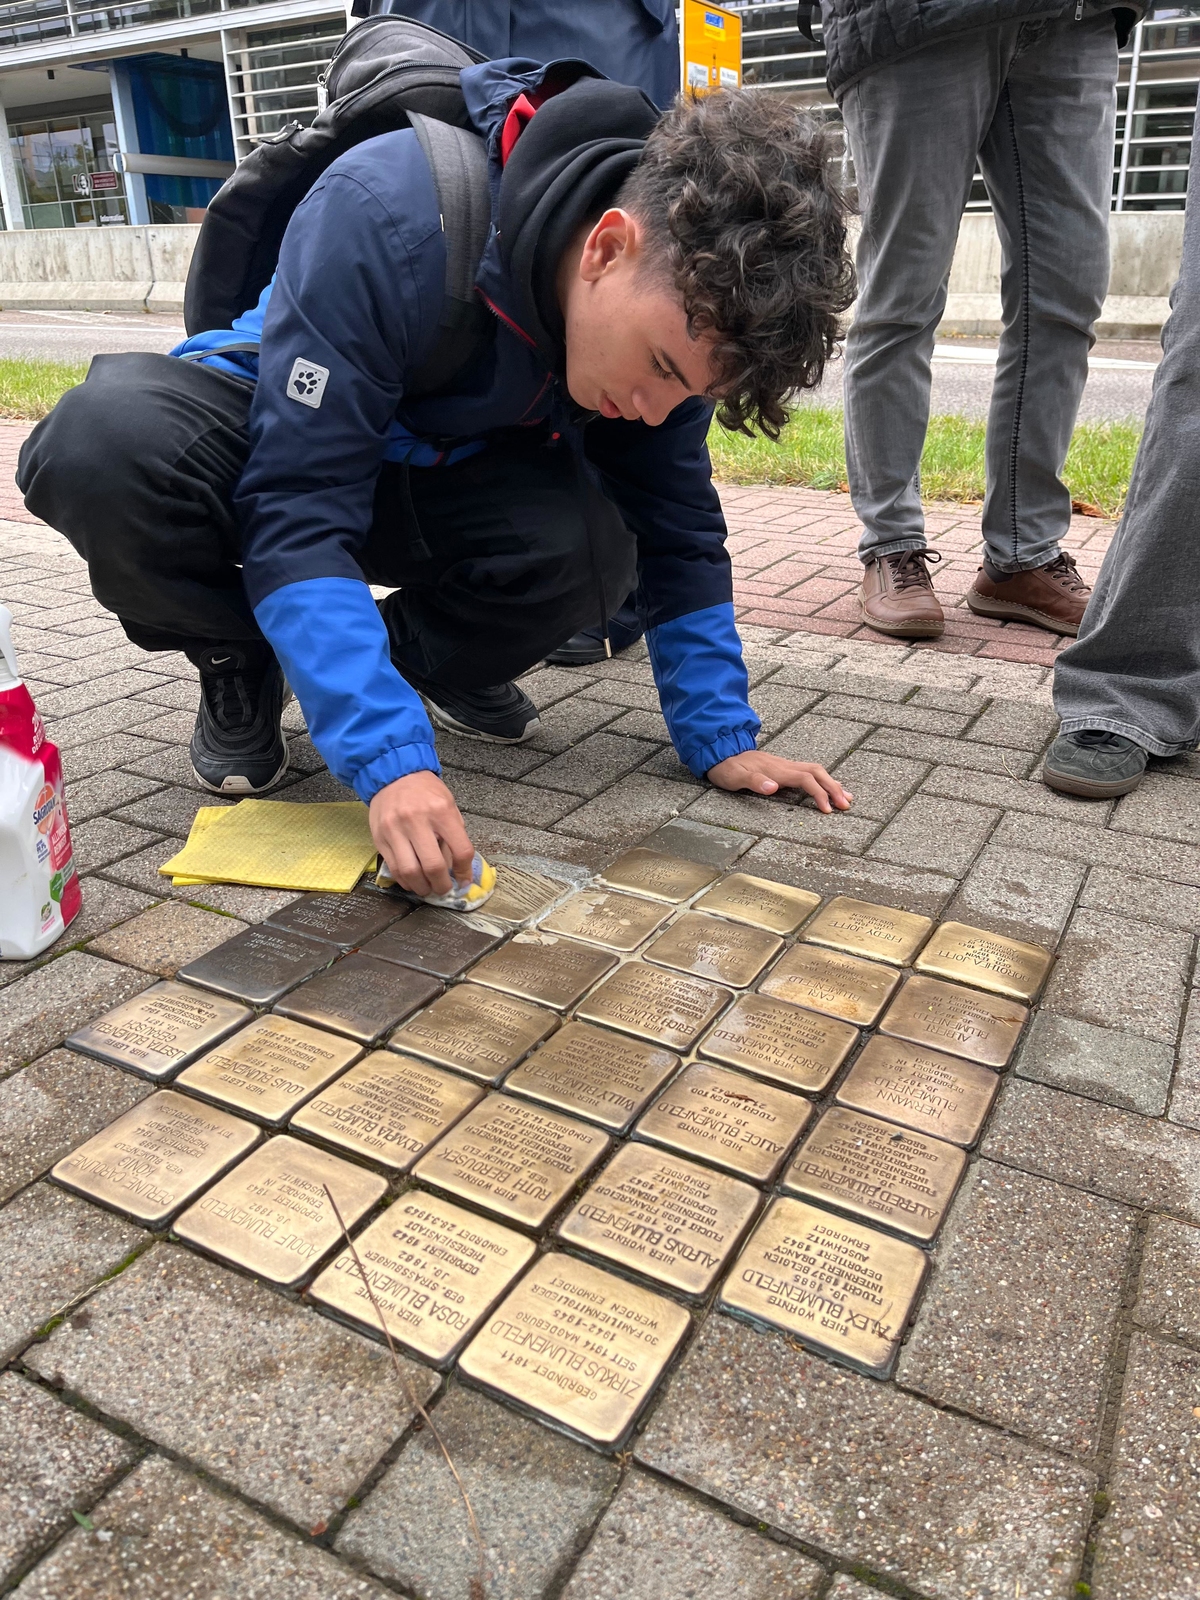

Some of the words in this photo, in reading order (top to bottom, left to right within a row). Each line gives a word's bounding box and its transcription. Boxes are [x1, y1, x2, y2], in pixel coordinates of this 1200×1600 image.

[827, 920, 863, 932] JOFFE
[865, 928, 902, 943] FREDY
[675, 942, 743, 964] BLUMENFELD
[685, 952, 720, 965] CLARA
[936, 949, 970, 962] JOFFE
[971, 958, 1028, 980] DOROTHEA
[787, 975, 860, 1001] BLUMENFELD
[806, 988, 835, 1001] CARL
[139, 1005, 161, 1014] 1942
[148, 1001, 208, 1023] THERESIENSTADT
[160, 1012, 203, 1029] DEPORTIERT
[591, 997, 664, 1022] BLUMENFELD
[87, 1020, 150, 1045] BLUMENFELD
[121, 1019, 178, 1042] GERAUSCH
[659, 1017, 696, 1034] ERICH
[911, 1012, 989, 1039] BLUMENFELD
[923, 1023, 971, 1042] ALBERT
[102, 1038, 130, 1050] LEBTE
[143, 1039, 188, 1060] LISETTA
[242, 1042, 264, 1052] 1942
[252, 1037, 317, 1062] THERESIENSTADT
[405, 1024, 479, 1053] BLUMENFELD
[421, 1039, 456, 1055] WOHNTE
[712, 1028, 786, 1057] BLUMENFELD
[128, 1047, 149, 1058] HIER
[264, 1050, 310, 1070] DEPORTIERT
[454, 1051, 476, 1063] HIER
[475, 1047, 511, 1064] FRITZ
[734, 1045, 772, 1061] WOHNTE
[772, 1058, 794, 1069] HIER
[786, 1053, 831, 1074] ULRICH
[205, 1054, 274, 1083] BLUMENFELD
[398, 1067, 443, 1087] ERMORDET
[522, 1064, 600, 1095] BLUMENFELD
[218, 1074, 246, 1087] LEBTE
[244, 1083, 266, 1095] HIER
[269, 1077, 306, 1095] LOUIS
[357, 1079, 394, 1096] DRANCY
[369, 1074, 394, 1086] 1942
[390, 1073, 438, 1095] AUSCHWITZ
[538, 1081, 576, 1097] WOHNTE
[337, 1081, 391, 1104] FRANKREICH
[393, 1084, 444, 1107] DEPORTIERT
[576, 1094, 600, 1106] HIER
[595, 1090, 637, 1110] WILLY
[689, 1087, 709, 1097] TOD
[709, 1093, 729, 1103] DEN
[873, 1076, 958, 1111] BLUMENFELD
[388, 1101, 412, 1113] 1938
[391, 1093, 440, 1115] INTERNIERT
[729, 1100, 741, 1108] IN
[741, 1104, 777, 1121] FLUCHT
[875, 1089, 942, 1118] HERMANN
[166, 1118, 203, 1135] BEFREIT
[309, 1099, 379, 1132] BLUMENFELD
[410, 1110, 443, 1126] FLUCHT
[491, 1117, 516, 1130] 1942
[656, 1102, 741, 1137] BLUMENFELD
[133, 1126, 155, 1138] 1944
[144, 1120, 209, 1150] THERESIENSTADT
[328, 1120, 364, 1138] WOHNTE
[374, 1125, 425, 1152] OLYMPIA
[480, 1122, 518, 1140] DRANCY
[512, 1117, 564, 1140] AUSCHWITZ
[675, 1121, 717, 1140] WOHNTE
[156, 1135, 204, 1158] DEPORTIERT
[362, 1135, 386, 1148] HIER
[518, 1128, 572, 1152] DEPORTIERT
[518, 1137, 572, 1162] INTERNIERT
[718, 1137, 743, 1151] HIER
[739, 1131, 785, 1154] ALICE
[851, 1135, 914, 1161] AUSCHWITZ
[112, 1141, 163, 1165] BLUMENFELD
[66, 1153, 129, 1184] CAROLINE
[115, 1155, 158, 1178] KÖNIG
[162, 1161, 184, 1174] GEB.
[436, 1147, 511, 1183] BEROUSEK
[262, 1177, 276, 1186] IN
[277, 1172, 329, 1198] AUSCHWITZ
[452, 1169, 494, 1189] WOHNTE
[628, 1176, 655, 1190] 1942
[651, 1172, 709, 1199] AUSCHWITZ
[659, 1165, 711, 1190] ERMORDET
[791, 1159, 879, 1197] BLUMENFELD
[245, 1183, 269, 1196] 1943
[277, 1184, 324, 1208] ERMORDET
[492, 1186, 518, 1201] HIER
[511, 1178, 552, 1201] RUTH
[594, 1185, 659, 1215] FRANKREICH
[616, 1182, 658, 1203] DRANCY
[272, 1194, 324, 1222] DEPORTIERT
[658, 1187, 718, 1215] DEPORTIERT
[876, 1189, 939, 1220] ALFRED
[198, 1196, 278, 1239] BLUMENFELD
[659, 1199, 716, 1226] INTERNIERT
[660, 1210, 688, 1226] 1938
[577, 1203, 663, 1245] BLUMENFELD
[687, 1222, 724, 1242] FLUCHT
[273, 1232, 321, 1259] ADOLF
[391, 1228, 420, 1247] 1942
[404, 1220, 486, 1263] THERESIENSTADT
[601, 1228, 646, 1251] WOHNTE
[781, 1235, 811, 1252] 1942
[805, 1232, 869, 1262] AUSCHWITZ
[812, 1223, 870, 1251] ERMORDET
[396, 1250, 428, 1269] 1862
[422, 1243, 480, 1275] DEPORTIERT
[647, 1248, 676, 1264] HIER
[662, 1238, 719, 1268] ALFONS
[762, 1250, 810, 1274] BELGIEN
[772, 1244, 817, 1266] DRANCY
[364, 1250, 439, 1291] STRASSBURGER
[430, 1266, 450, 1280] JG.
[816, 1249, 882, 1281] DEPORTIERT
[333, 1254, 429, 1310] BLUMENFELD
[810, 1269, 840, 1286] 1937
[819, 1261, 883, 1293] INTERNIERT
[354, 1286, 396, 1311] WOHNTE
[439, 1286, 465, 1304] GEB.
[548, 1276, 605, 1306] ERMORDET
[740, 1268, 844, 1319] BLUMENFELD
[841, 1282, 883, 1305] FLUCHT
[395, 1307, 423, 1326] HIER
[426, 1300, 470, 1331] ROSA
[530, 1283, 643, 1339] FAMILIENMITGLIEDER
[609, 1302, 658, 1329] WERDEN
[766, 1294, 815, 1320] WOHNTE
[515, 1310, 580, 1344] MAGDEBURG
[552, 1307, 617, 1342] 1942-1945
[818, 1316, 849, 1335] HIER
[844, 1309, 891, 1339] ALEX
[489, 1317, 586, 1372] BLUMENFELD
[582, 1339, 609, 1357] 1914
[643, 1333, 659, 1346] 30
[499, 1349, 529, 1368] 1811
[609, 1352, 637, 1371] SEIT
[531, 1363, 598, 1401] GEGRÜNDET
[582, 1360, 642, 1399] ZIRKUS
